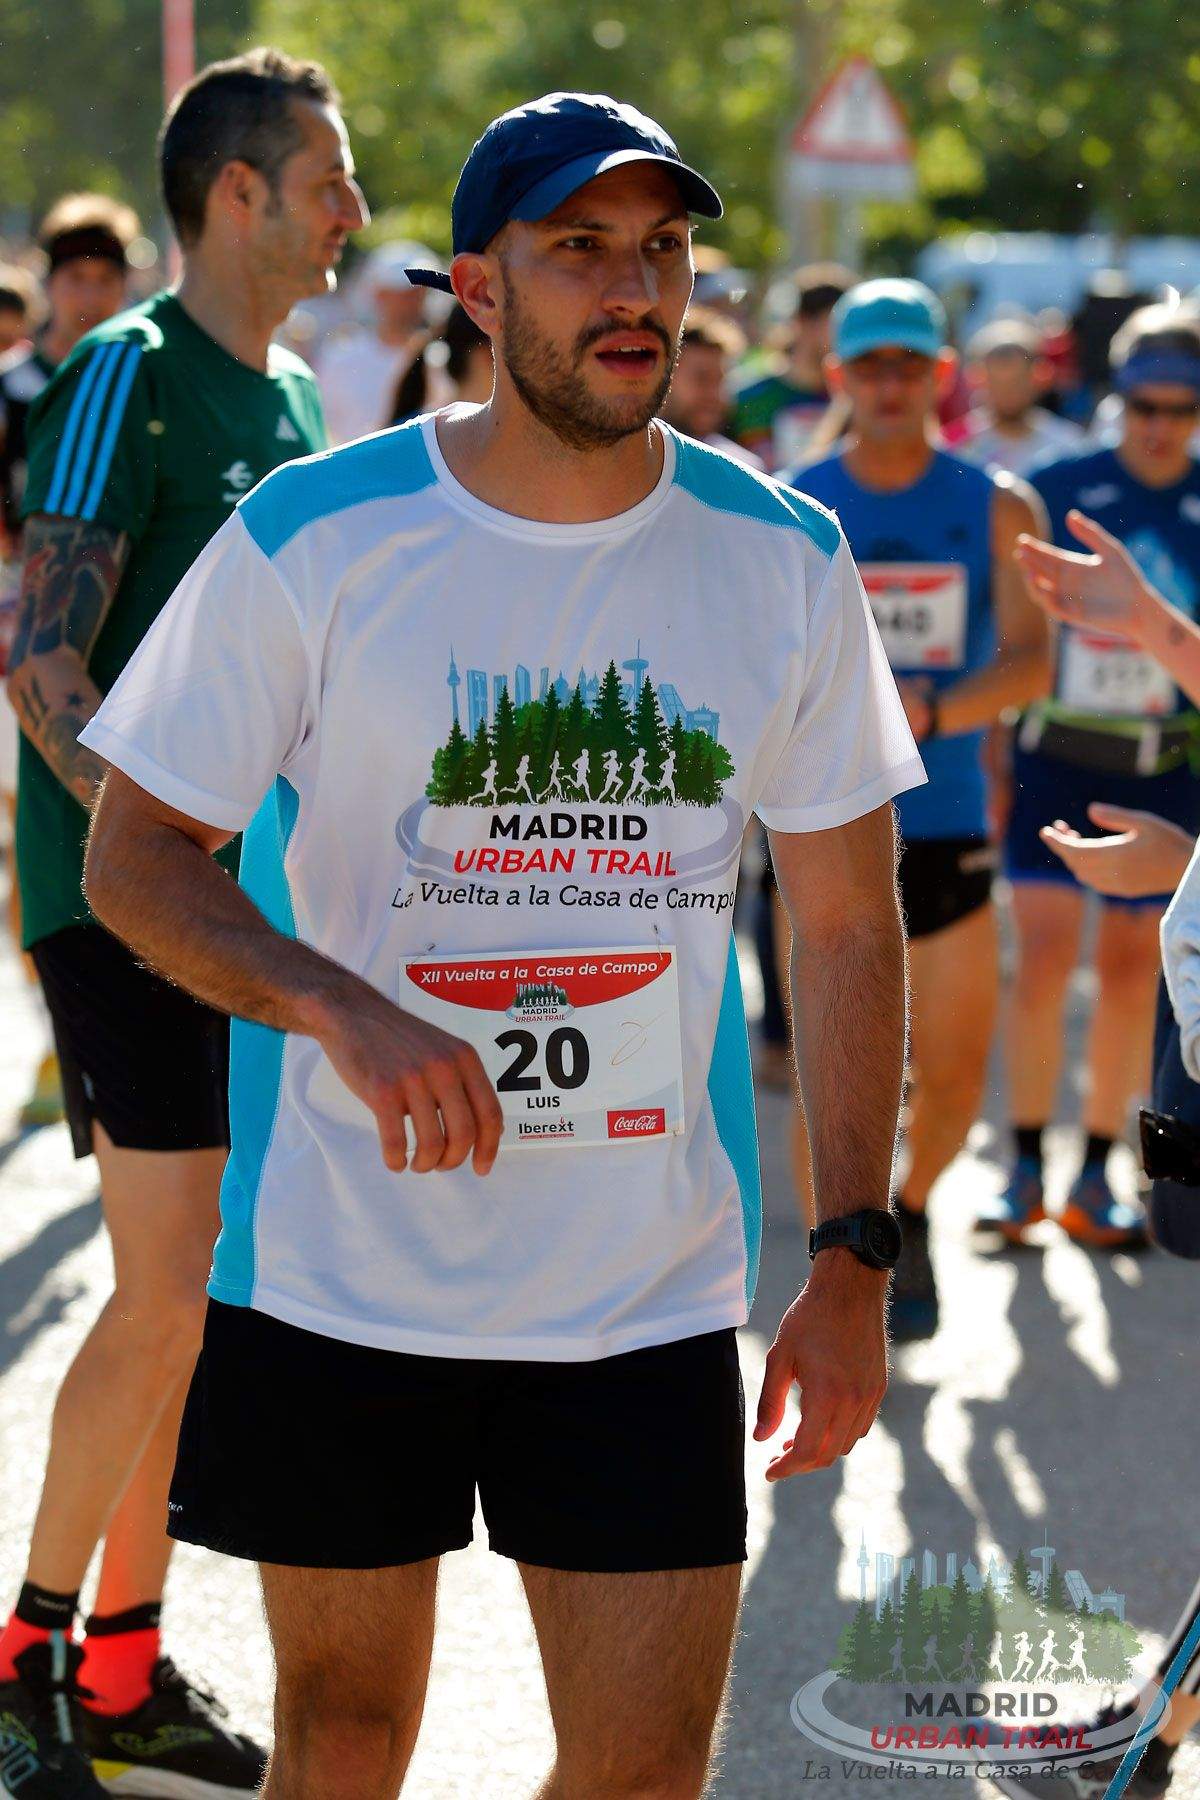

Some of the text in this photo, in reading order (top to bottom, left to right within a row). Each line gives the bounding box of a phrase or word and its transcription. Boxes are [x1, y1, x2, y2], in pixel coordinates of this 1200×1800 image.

[489, 813, 648, 841] MADRID
[454, 848, 677, 877] URBAN TRAIL
[391, 888, 414, 909] La
[420, 883, 500, 905] Vuelta
[506, 891, 521, 906] a
[529, 885, 550, 906] la
[559, 885, 621, 907] Casa
[629, 888, 659, 909] de
[420, 962, 658, 984] XII Vuelta a la Casa de Campo
[515, 1015, 543, 1023] URBAN
[522, 1007, 558, 1015] MADRID
[493, 1026, 590, 1093] 20
[527, 1096, 560, 1109] LUIS
[518, 1120, 575, 1134] Iberext
